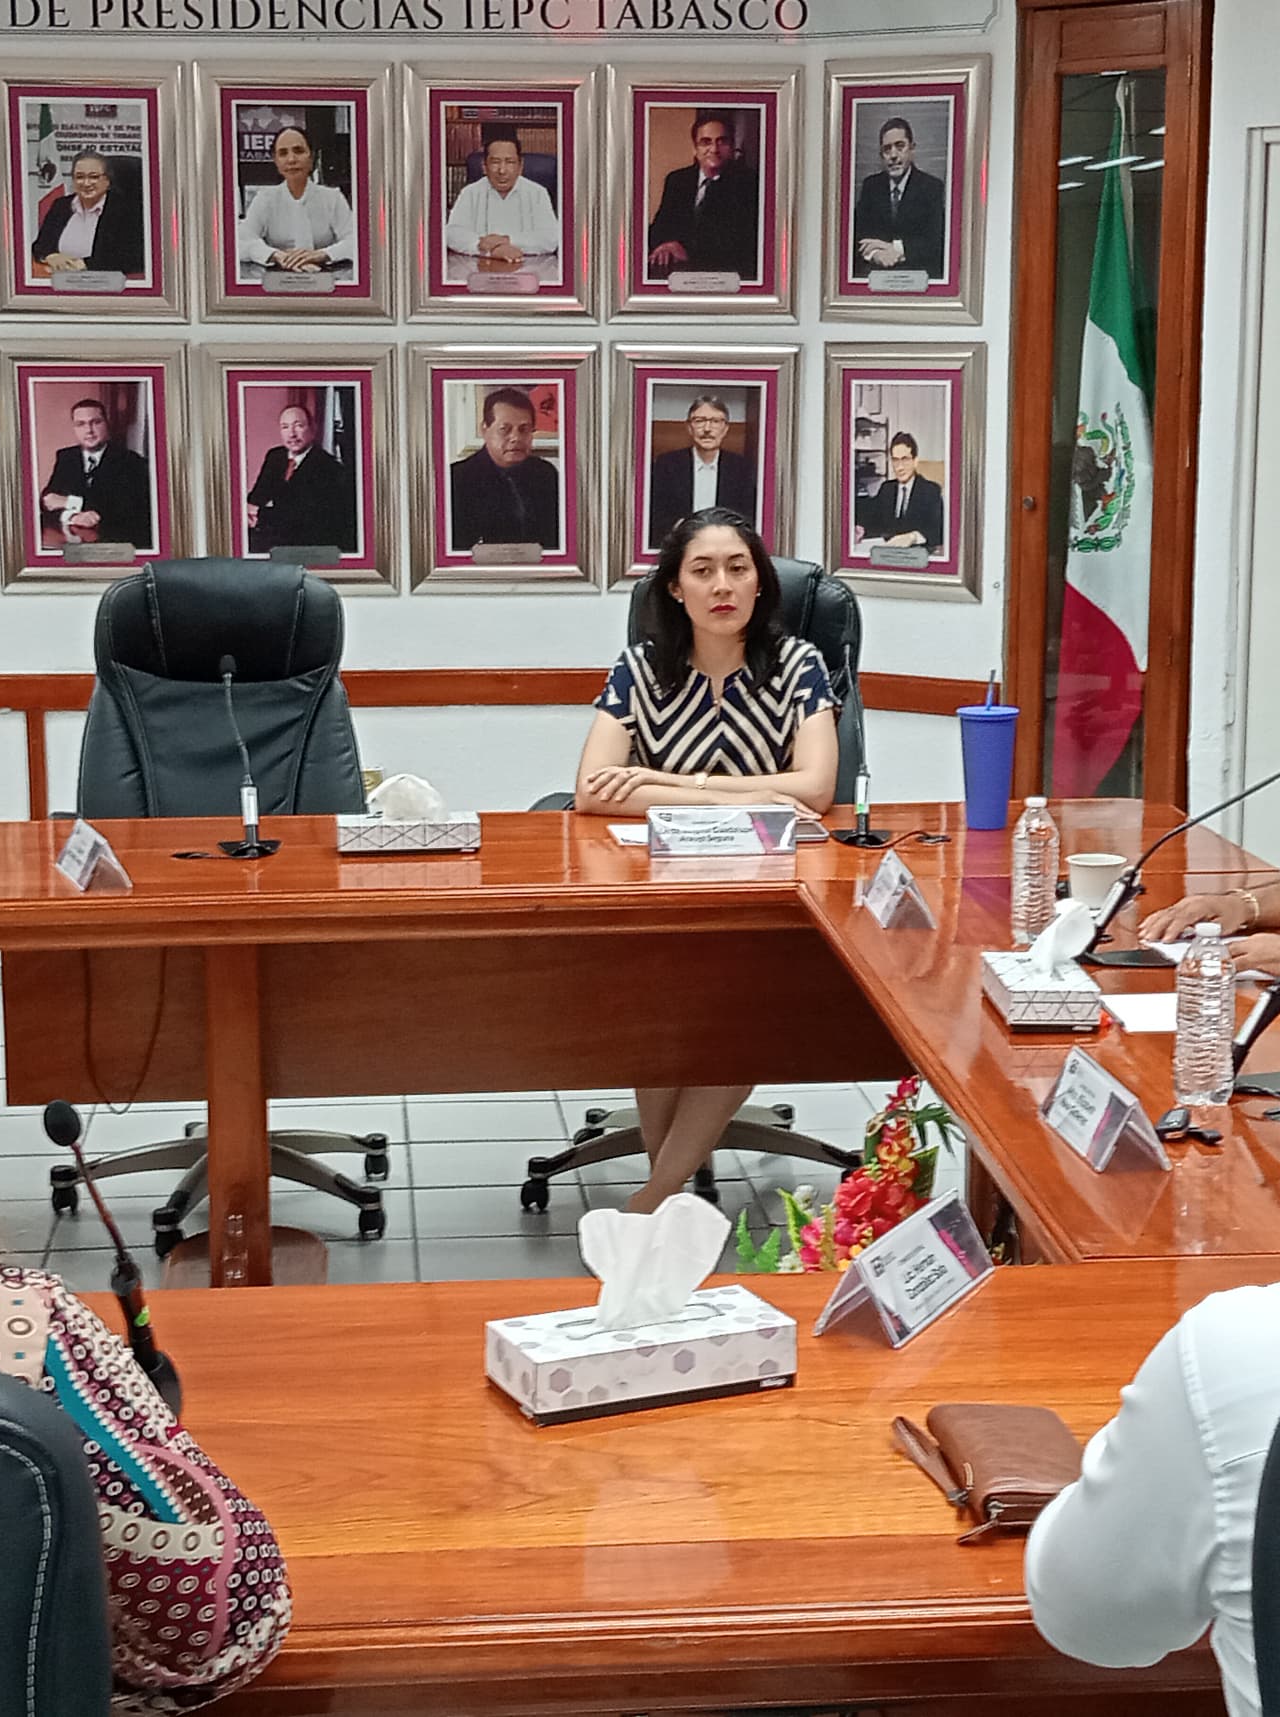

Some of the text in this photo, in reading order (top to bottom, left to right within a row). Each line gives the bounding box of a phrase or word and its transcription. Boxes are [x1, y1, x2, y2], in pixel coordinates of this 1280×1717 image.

[9, 0, 71, 28] DE
[90, 0, 444, 30] PRESIDENCIAS
[463, 0, 571, 30] IEPC
[592, 0, 809, 31] TABASCO
[56, 144, 97, 152] ONSEJO
[243, 134, 277, 150] IEP
